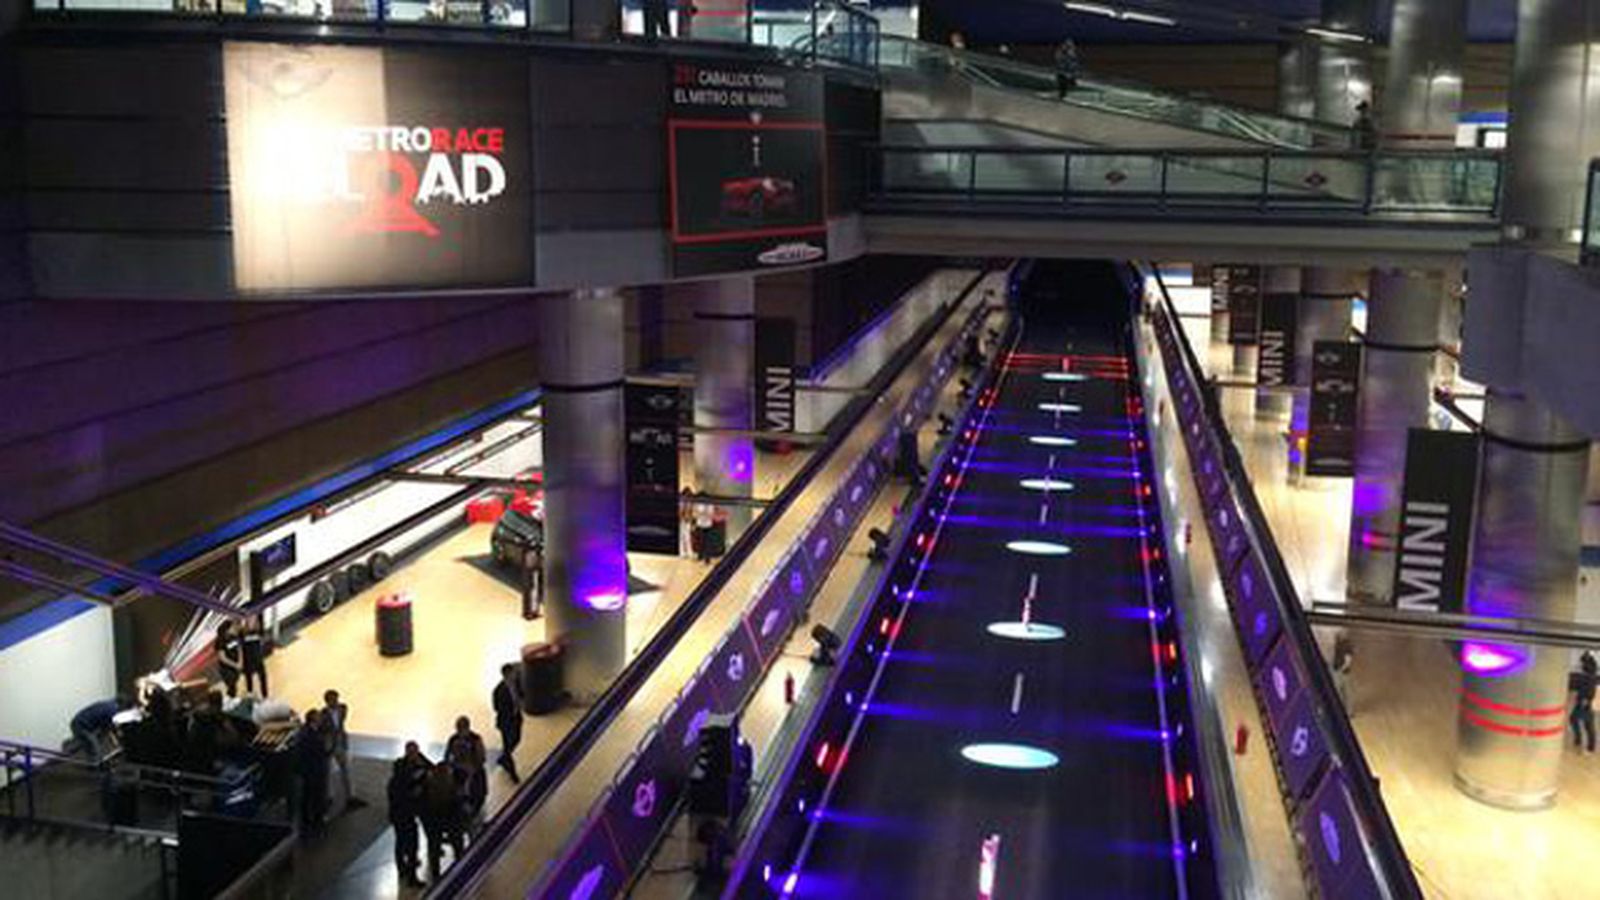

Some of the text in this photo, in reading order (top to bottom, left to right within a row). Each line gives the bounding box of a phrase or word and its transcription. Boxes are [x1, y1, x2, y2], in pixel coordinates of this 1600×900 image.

[674, 89, 687, 103] EL
[730, 91, 745, 106] DE
[1261, 330, 1284, 386] MINI
[766, 366, 792, 432] MINI
[1397, 501, 1450, 612] MINI
